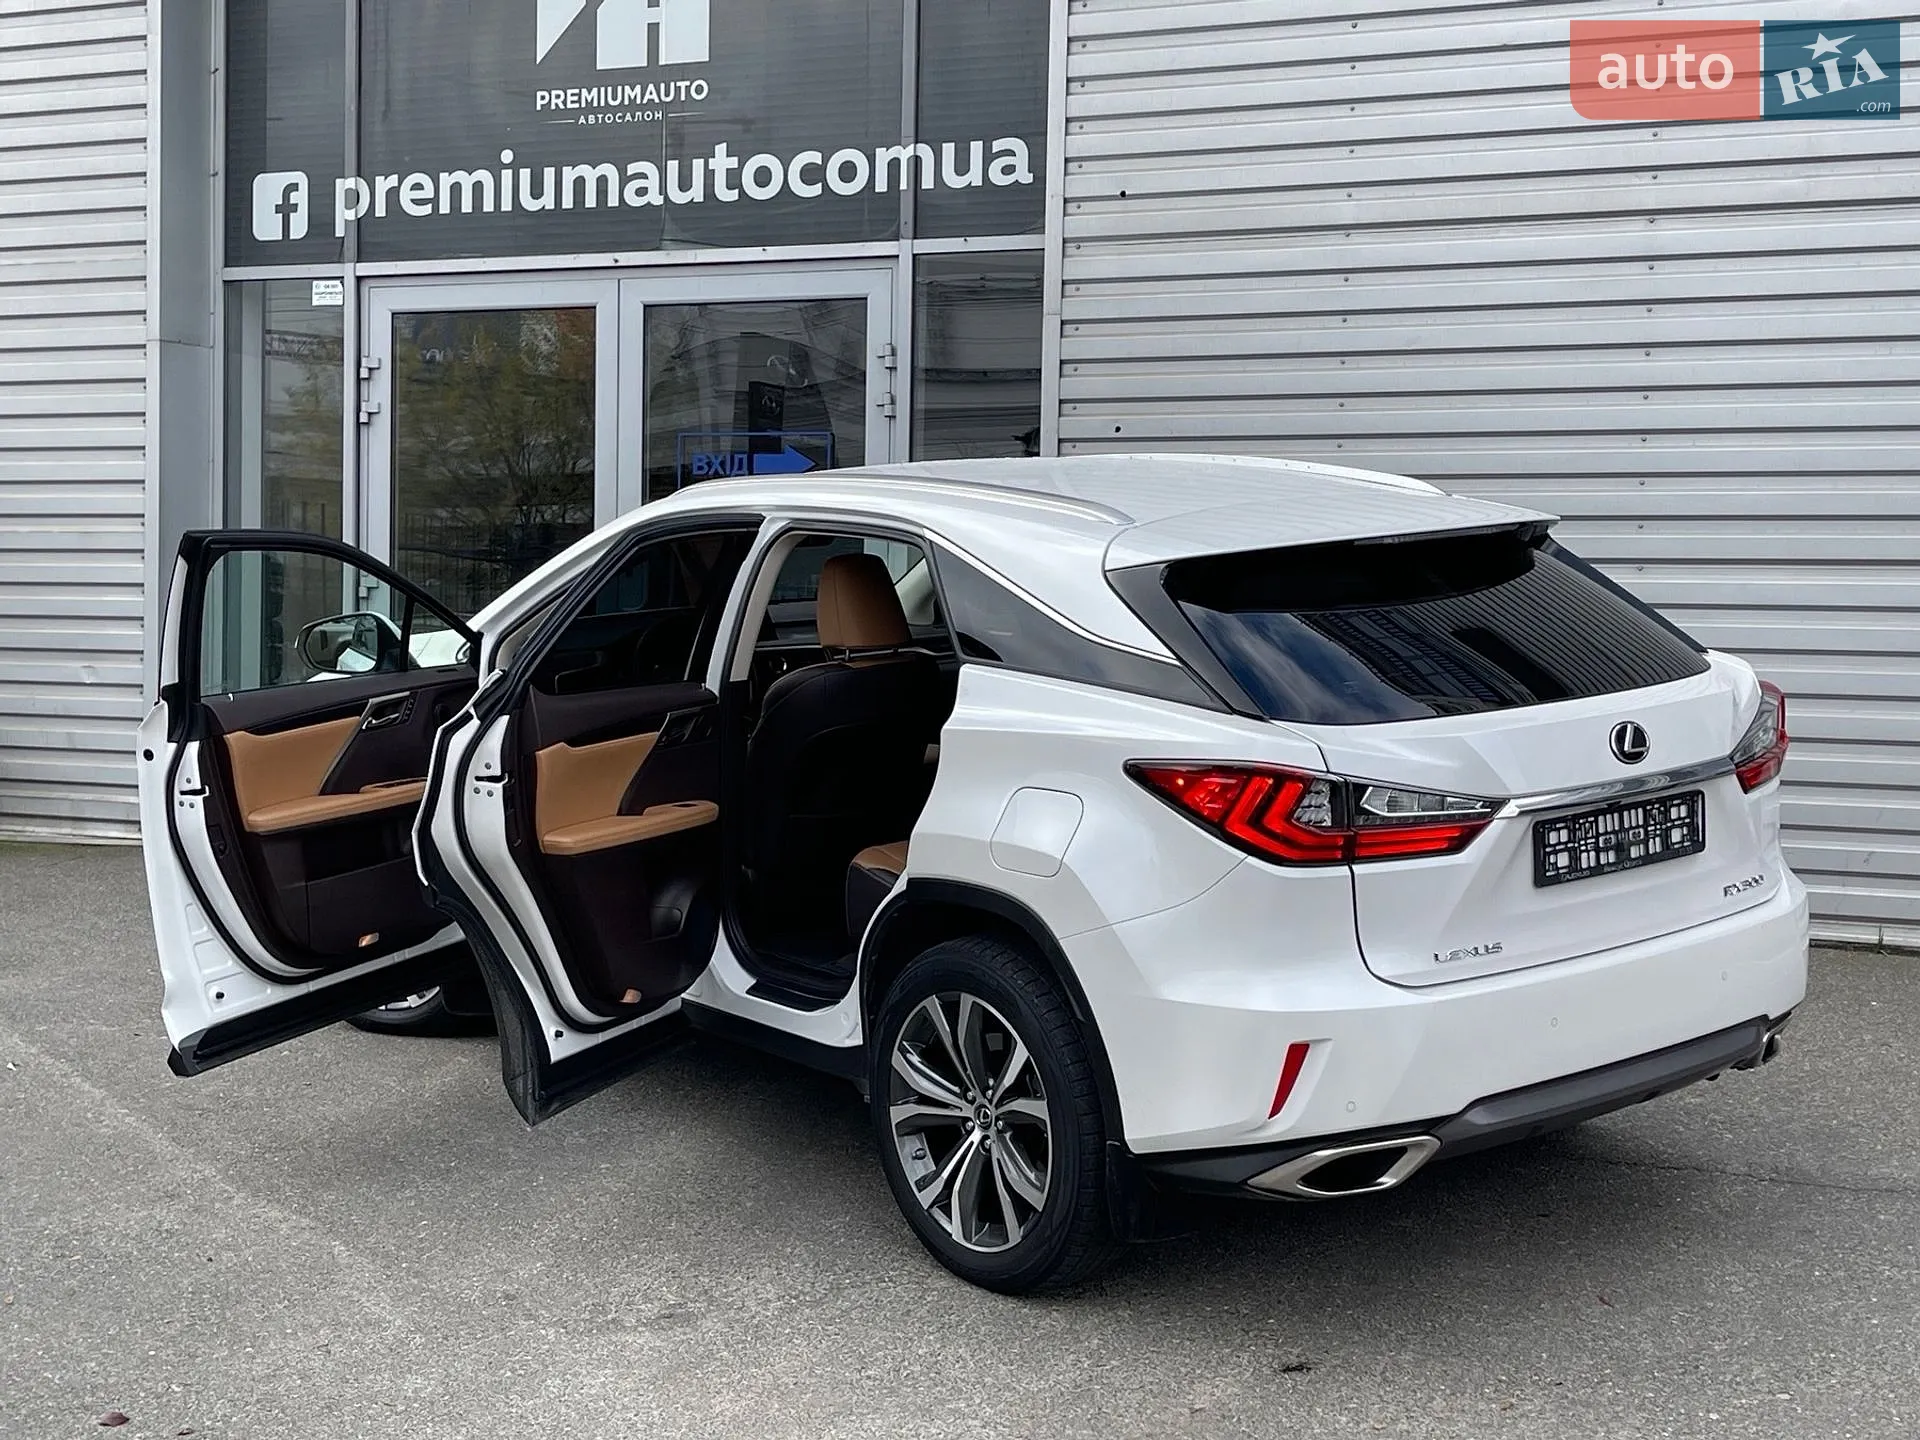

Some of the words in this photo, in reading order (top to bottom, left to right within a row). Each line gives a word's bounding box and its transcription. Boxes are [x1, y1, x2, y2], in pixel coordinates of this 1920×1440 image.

[536, 79, 709, 111] PREMIUMAUTO
[578, 110, 664, 125] АВТОСАЛОН
[335, 136, 1034, 238] premiumautocomua
[691, 452, 749, 476] ВХІД
[1433, 942, 1503, 964] LEXUS
